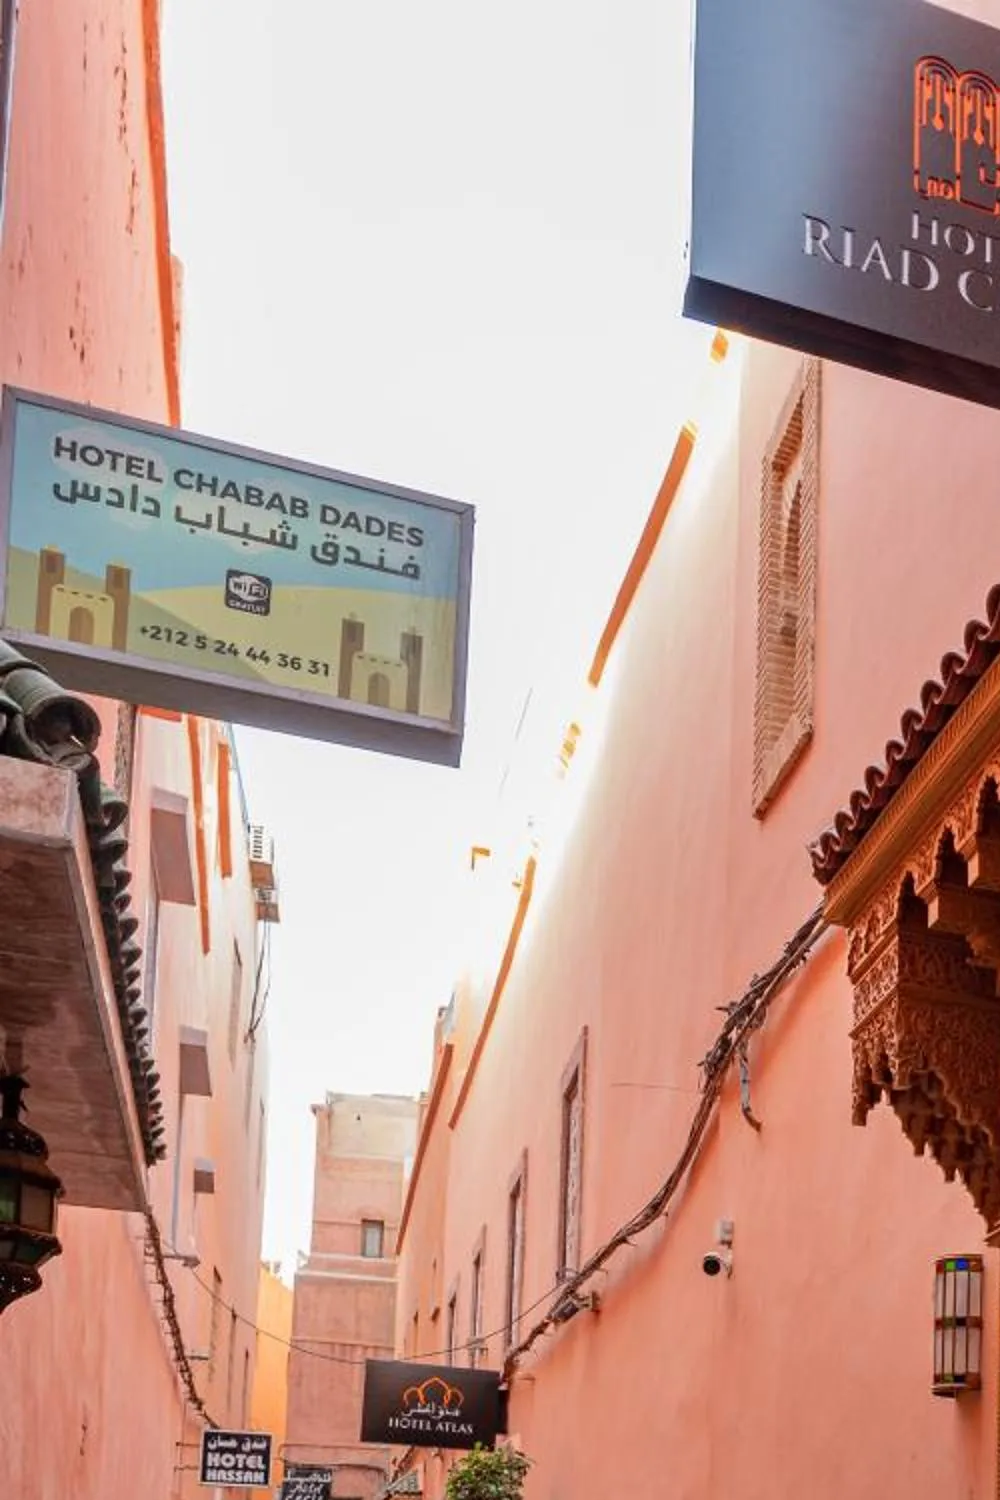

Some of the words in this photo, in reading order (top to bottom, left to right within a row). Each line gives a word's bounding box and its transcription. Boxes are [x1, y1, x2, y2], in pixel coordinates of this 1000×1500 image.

[801, 212, 940, 292] RIAD
[52, 479, 161, 519] دادس
[53, 435, 164, 484] HOTEL
[173, 468, 309, 519] CHABAB
[319, 503, 425, 547] DADES
[174, 505, 299, 551] شباب
[310, 532, 421, 581] فندق
[228, 599, 266, 614] GRATUIT
[140, 625, 188, 647] +212
[194, 635, 208, 650] 5
[213, 639, 240, 657] 24
[246, 646, 271, 665] 44
[277, 653, 302, 671] 36
[308, 659, 330, 677] 31
[388, 1417, 432, 1431] HOTEL
[435, 1421, 474, 1434] ATLAS
[206, 1452, 266, 1470] HOTEL
[206, 1468, 265, 1483] HASSAN
